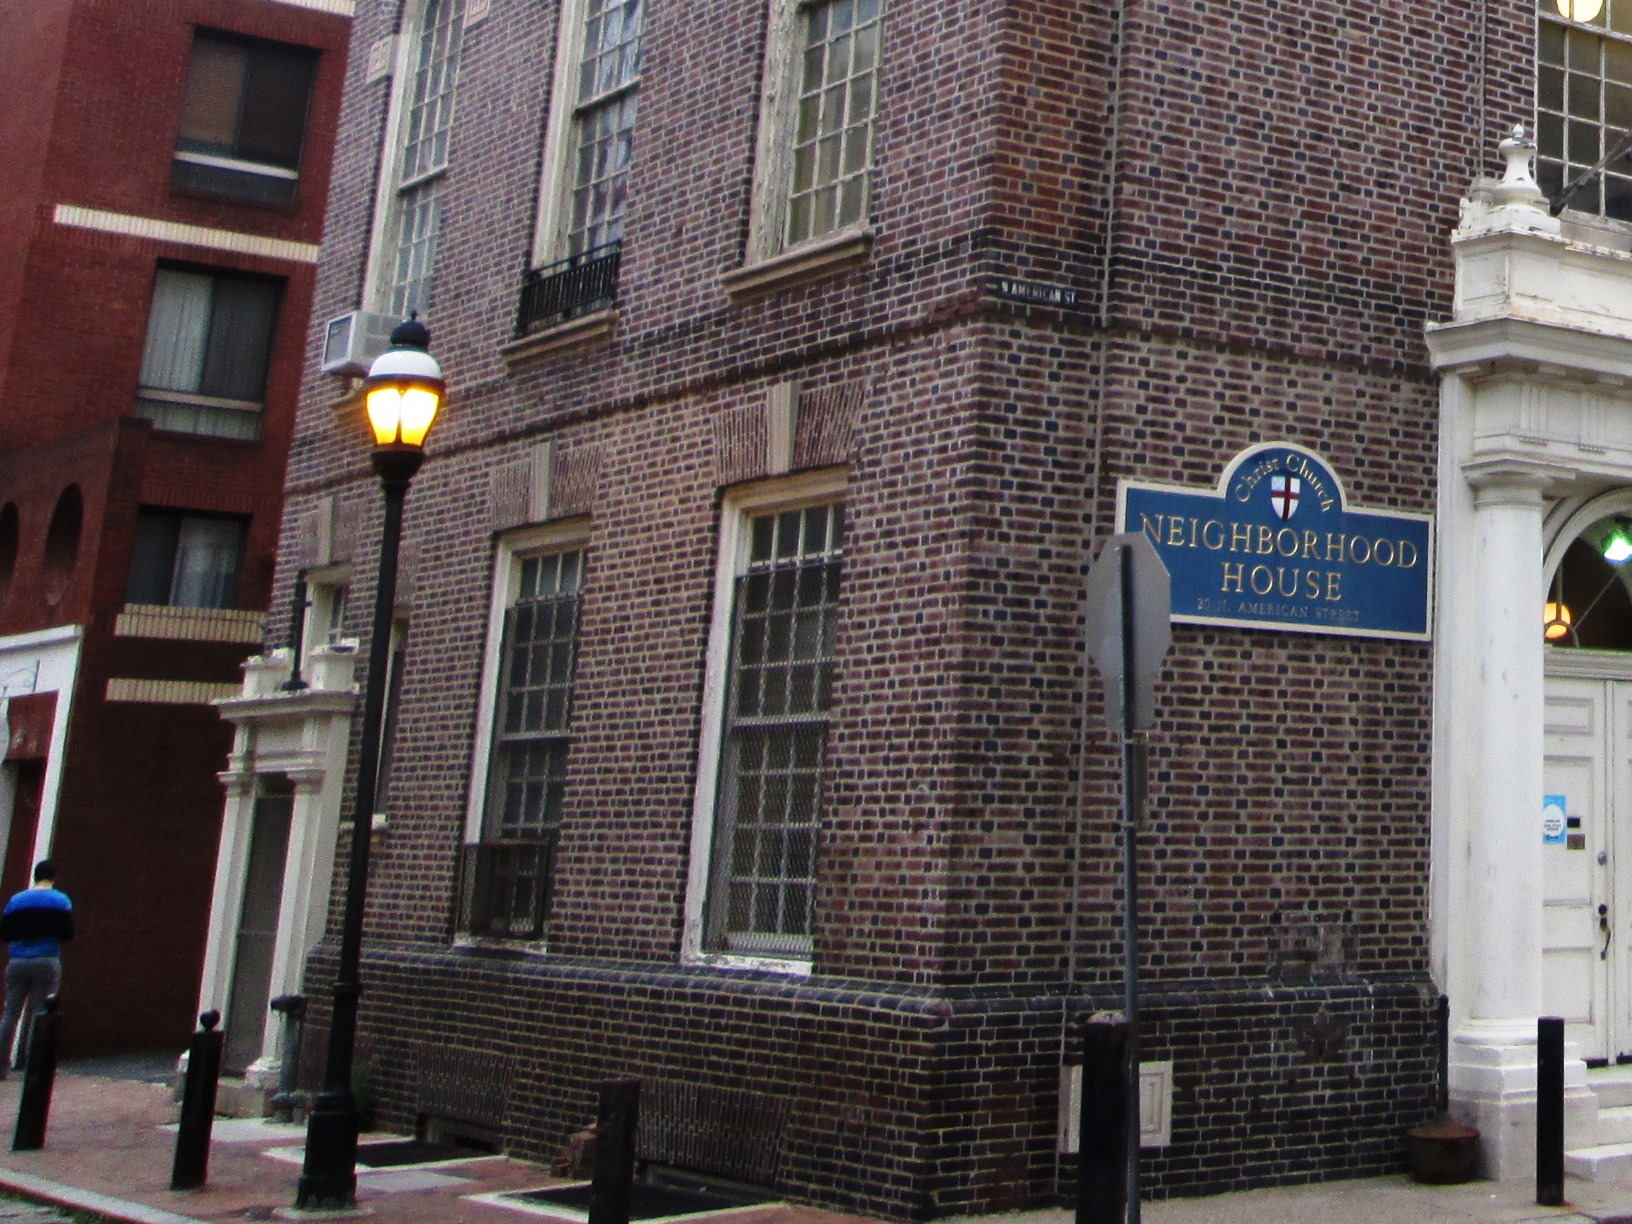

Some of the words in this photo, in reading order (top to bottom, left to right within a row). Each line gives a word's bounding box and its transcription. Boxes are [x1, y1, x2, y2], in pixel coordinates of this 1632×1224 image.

[1235, 458, 1280, 503] Christ
[1286, 453, 1335, 513] Church
[1139, 512, 1418, 568] NEIGHBORHOOD
[1220, 562, 1343, 601] HOUSE
[1197, 598, 1211, 610] 20
[1237, 601, 1308, 618] AMERICAN
[1315, 607, 1360, 622] STREET
